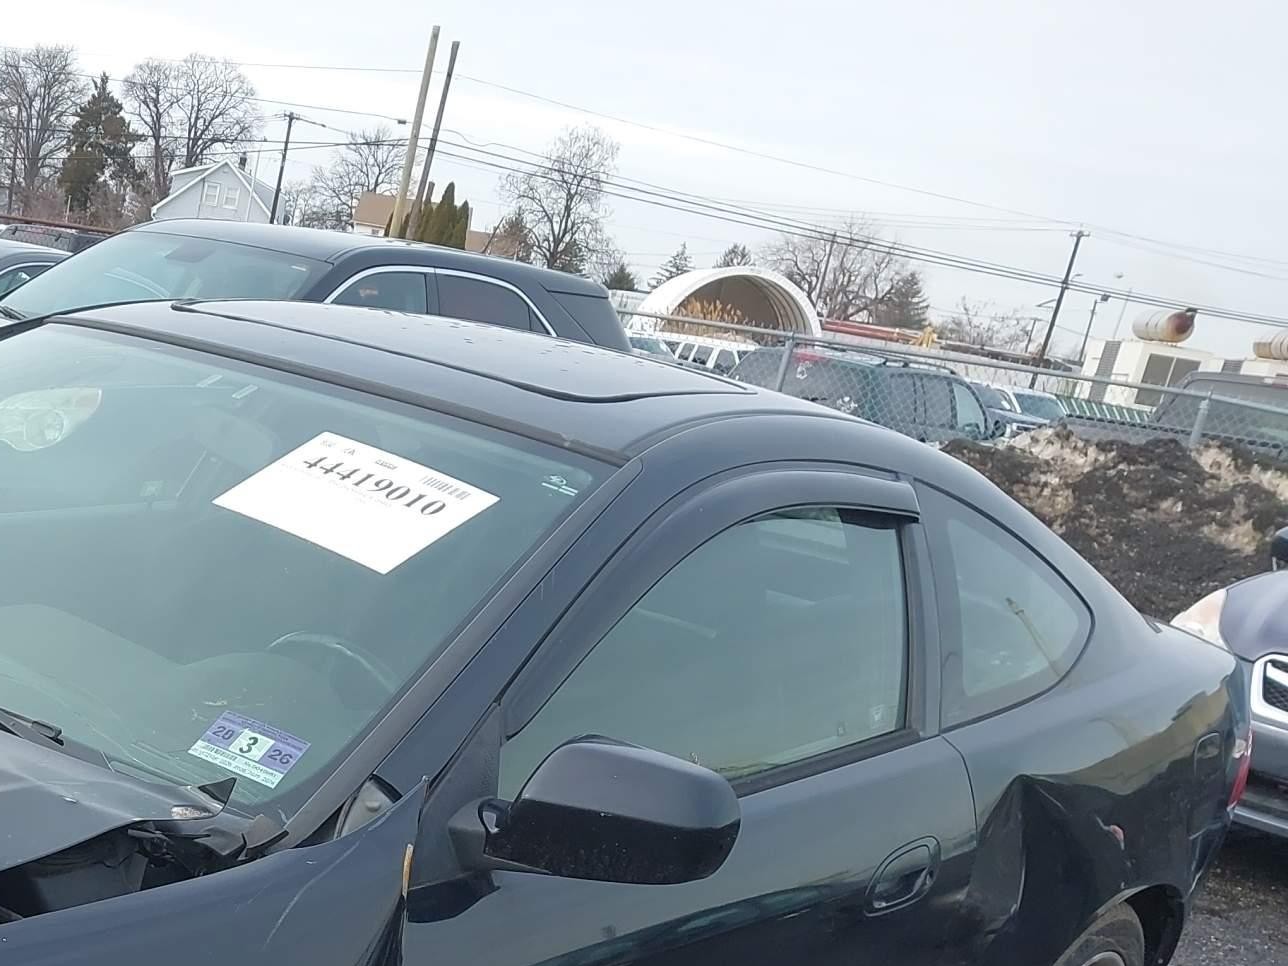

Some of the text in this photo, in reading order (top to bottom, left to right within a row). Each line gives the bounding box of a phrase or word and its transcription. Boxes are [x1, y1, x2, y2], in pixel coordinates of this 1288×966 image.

[303, 456, 447, 516] 44419010
[212, 725, 235, 741] 20
[238, 736, 259, 755] 3
[267, 748, 293, 765] 26
